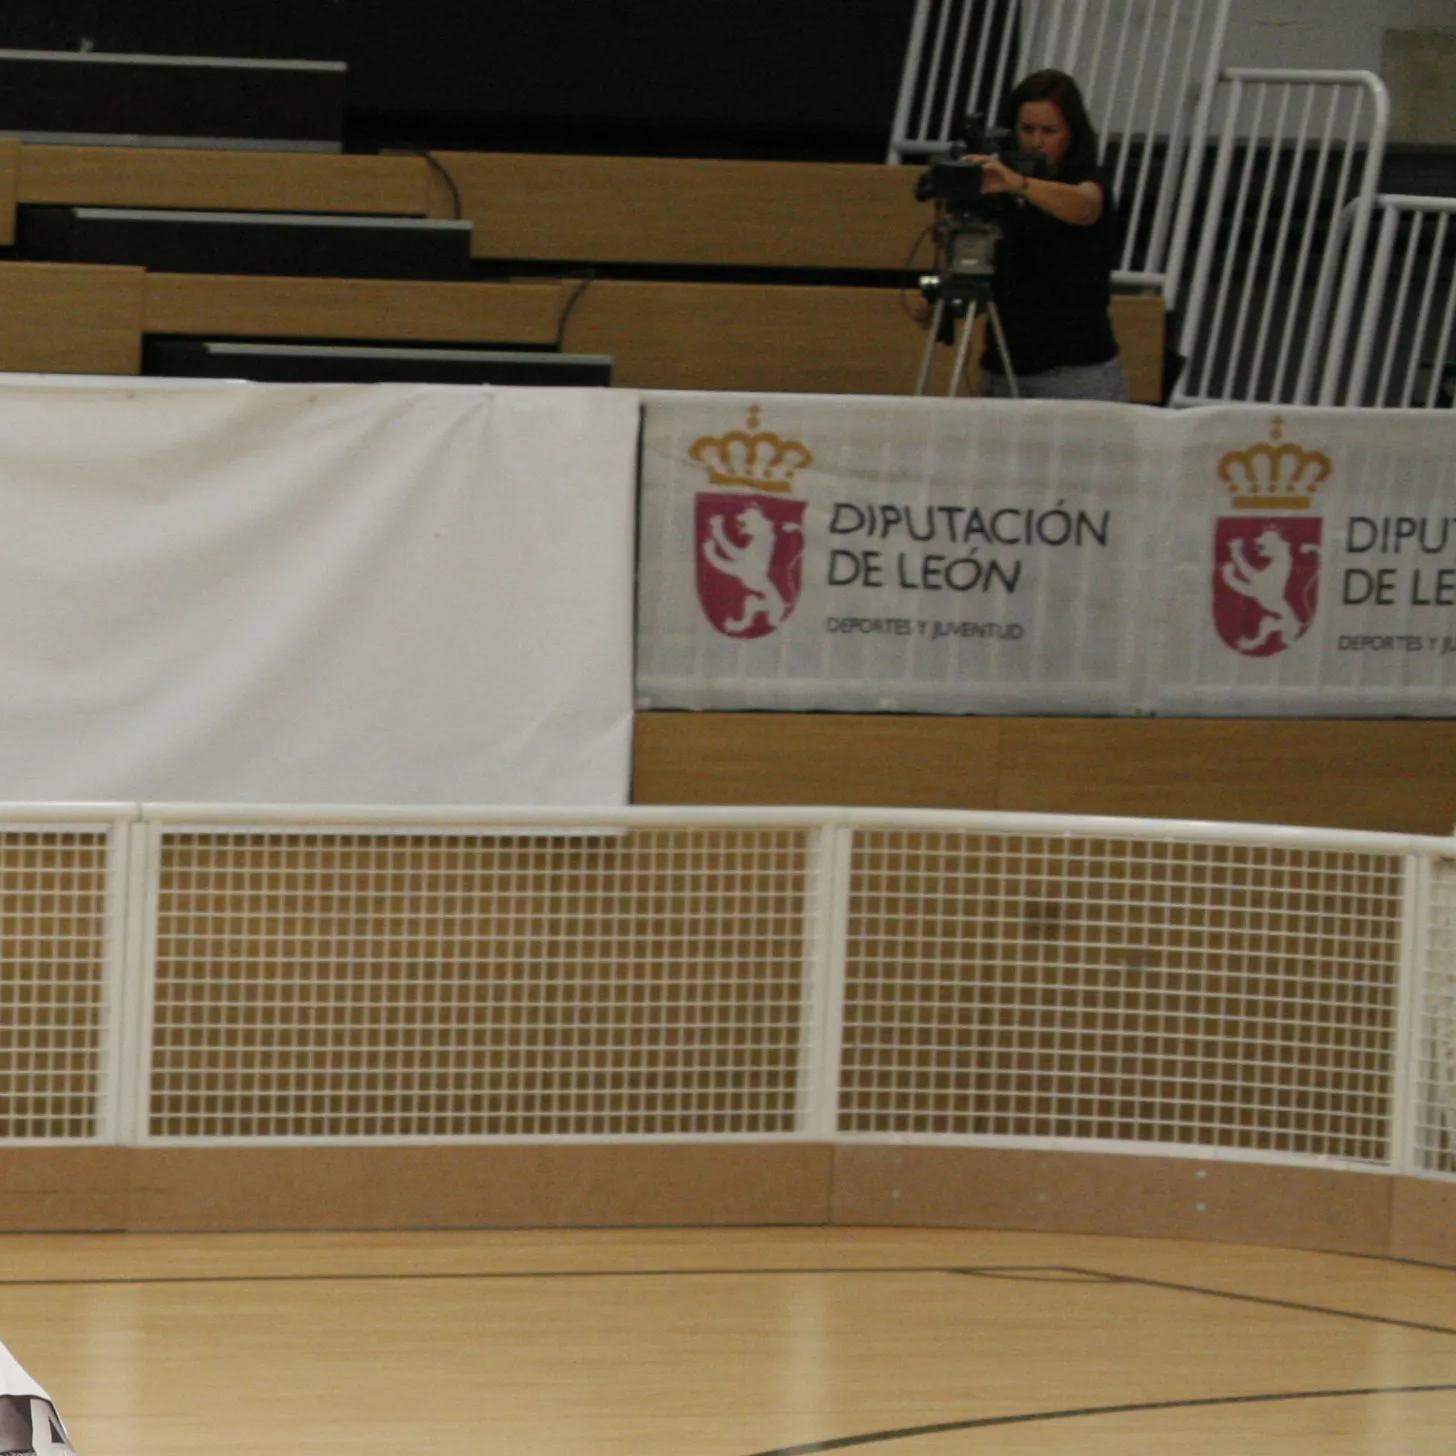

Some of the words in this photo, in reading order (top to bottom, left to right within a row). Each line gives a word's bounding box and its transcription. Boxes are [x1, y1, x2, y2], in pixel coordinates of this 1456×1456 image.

[829, 499, 1111, 547] DIPUTACIÓN
[1346, 516, 1456, 554] DIPU
[828, 549, 884, 588] DE
[898, 547, 1021, 593] LEÓN
[1343, 568, 1397, 605] DE
[826, 617, 911, 636] DEPORTES
[916, 619, 929, 636] Y
[931, 620, 1024, 641] JUVENTUD
[1338, 634, 1423, 651] DEPORTES
[1428, 636, 1438, 650] Y
